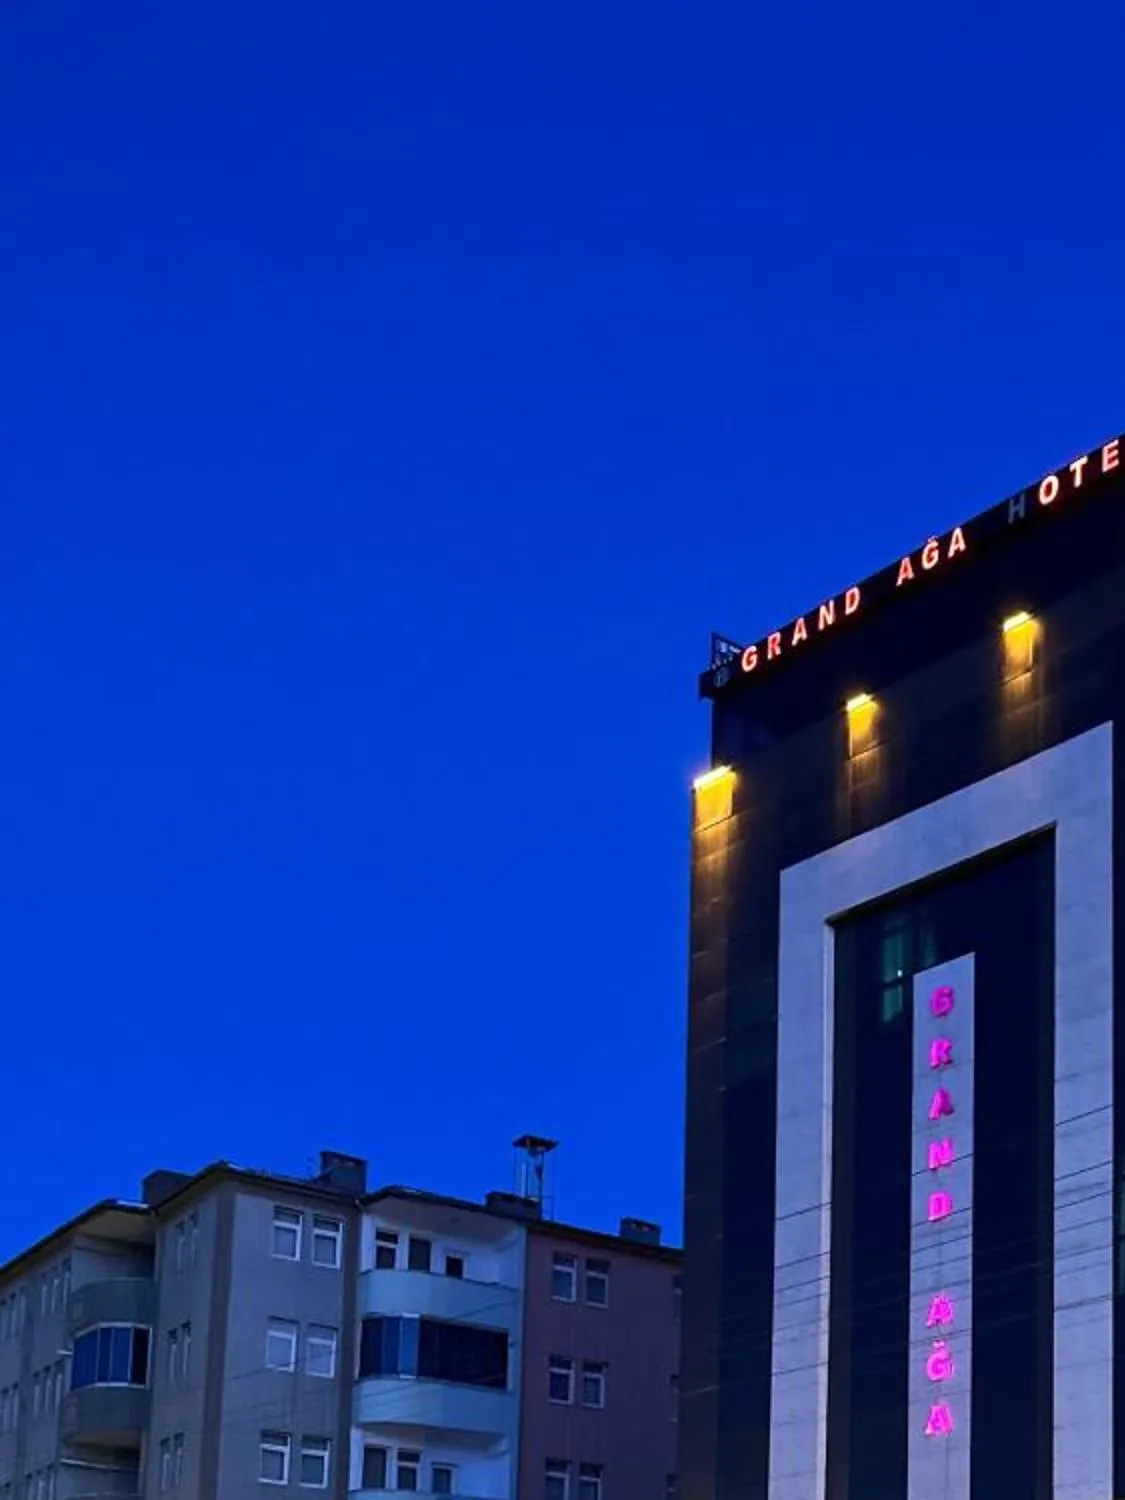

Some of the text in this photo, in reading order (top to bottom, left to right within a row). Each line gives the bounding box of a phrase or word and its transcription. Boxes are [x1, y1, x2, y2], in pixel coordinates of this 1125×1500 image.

[741, 586, 861, 672] GRAND
[896, 527, 967, 586] AĞA
[924, 985, 955, 1437] GRAND AĞA
